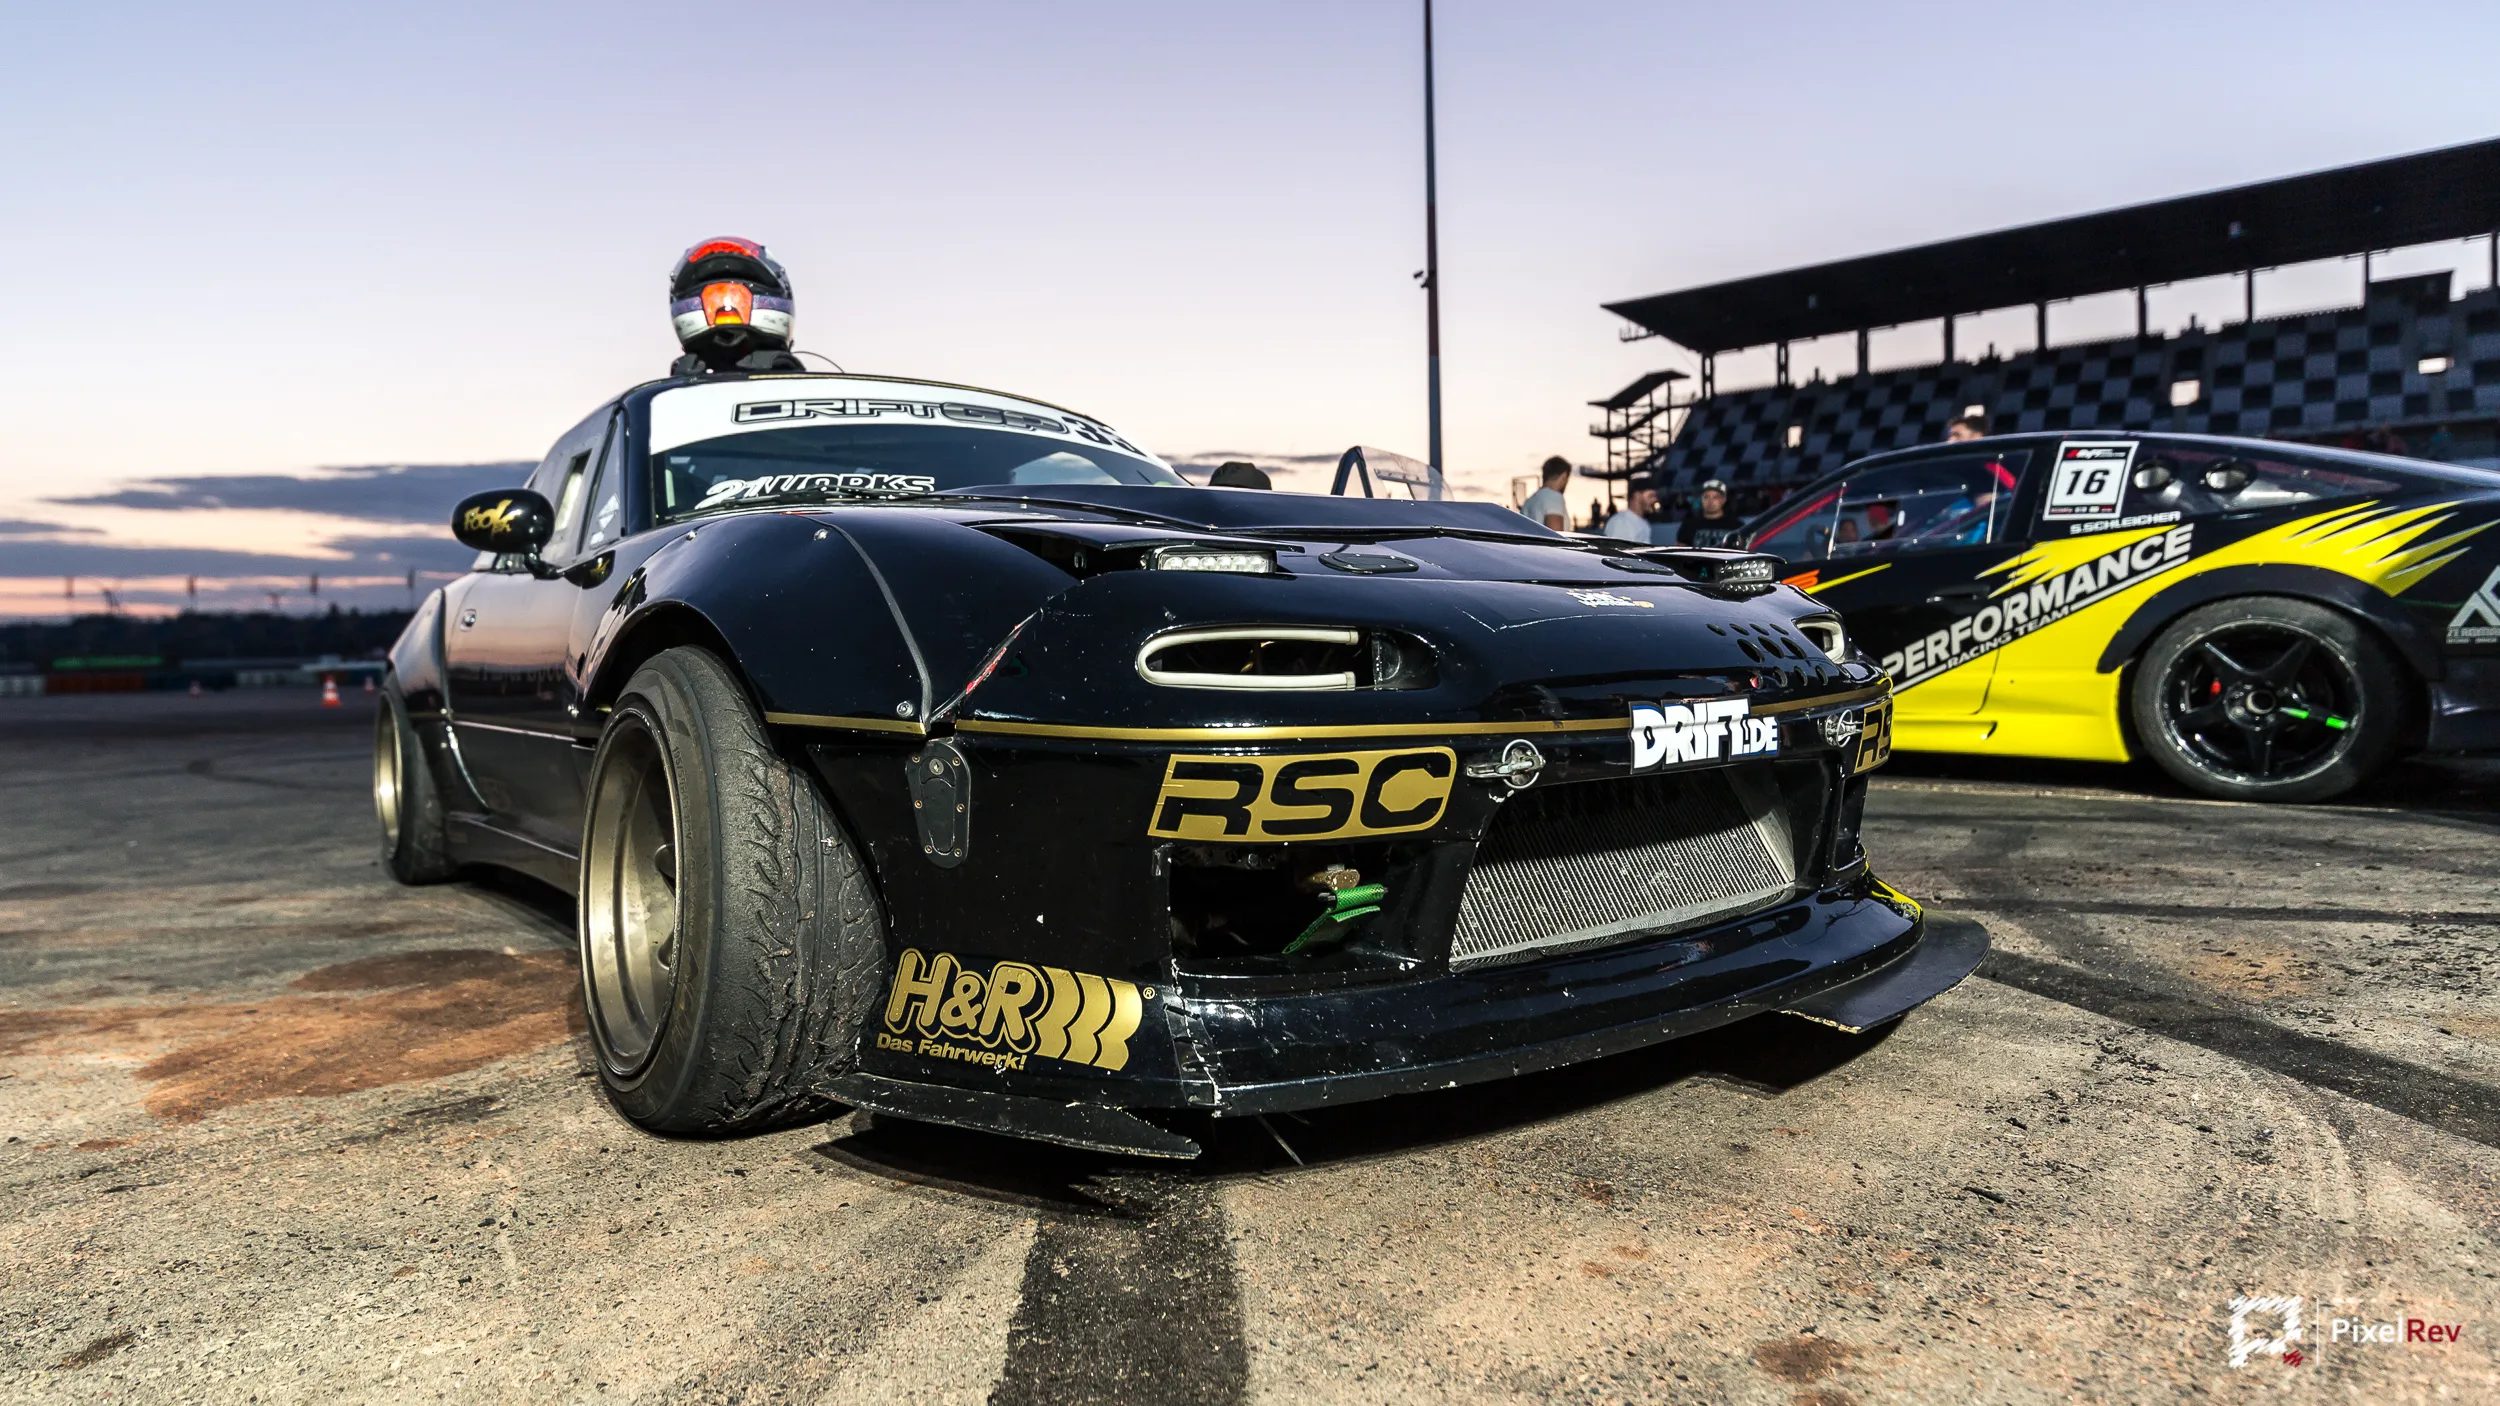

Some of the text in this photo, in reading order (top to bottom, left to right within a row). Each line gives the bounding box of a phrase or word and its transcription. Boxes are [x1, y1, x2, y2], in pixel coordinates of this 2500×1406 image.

[2065, 468, 2111, 496] 16
[1882, 523, 2194, 678] PERFORMANCE
[1948, 605, 2069, 669] RACING TEAM
[1155, 751, 1450, 836] RSC
[885, 948, 1048, 1053] H&R
[877, 1032, 1027, 1070] Das Fahrwerk!
